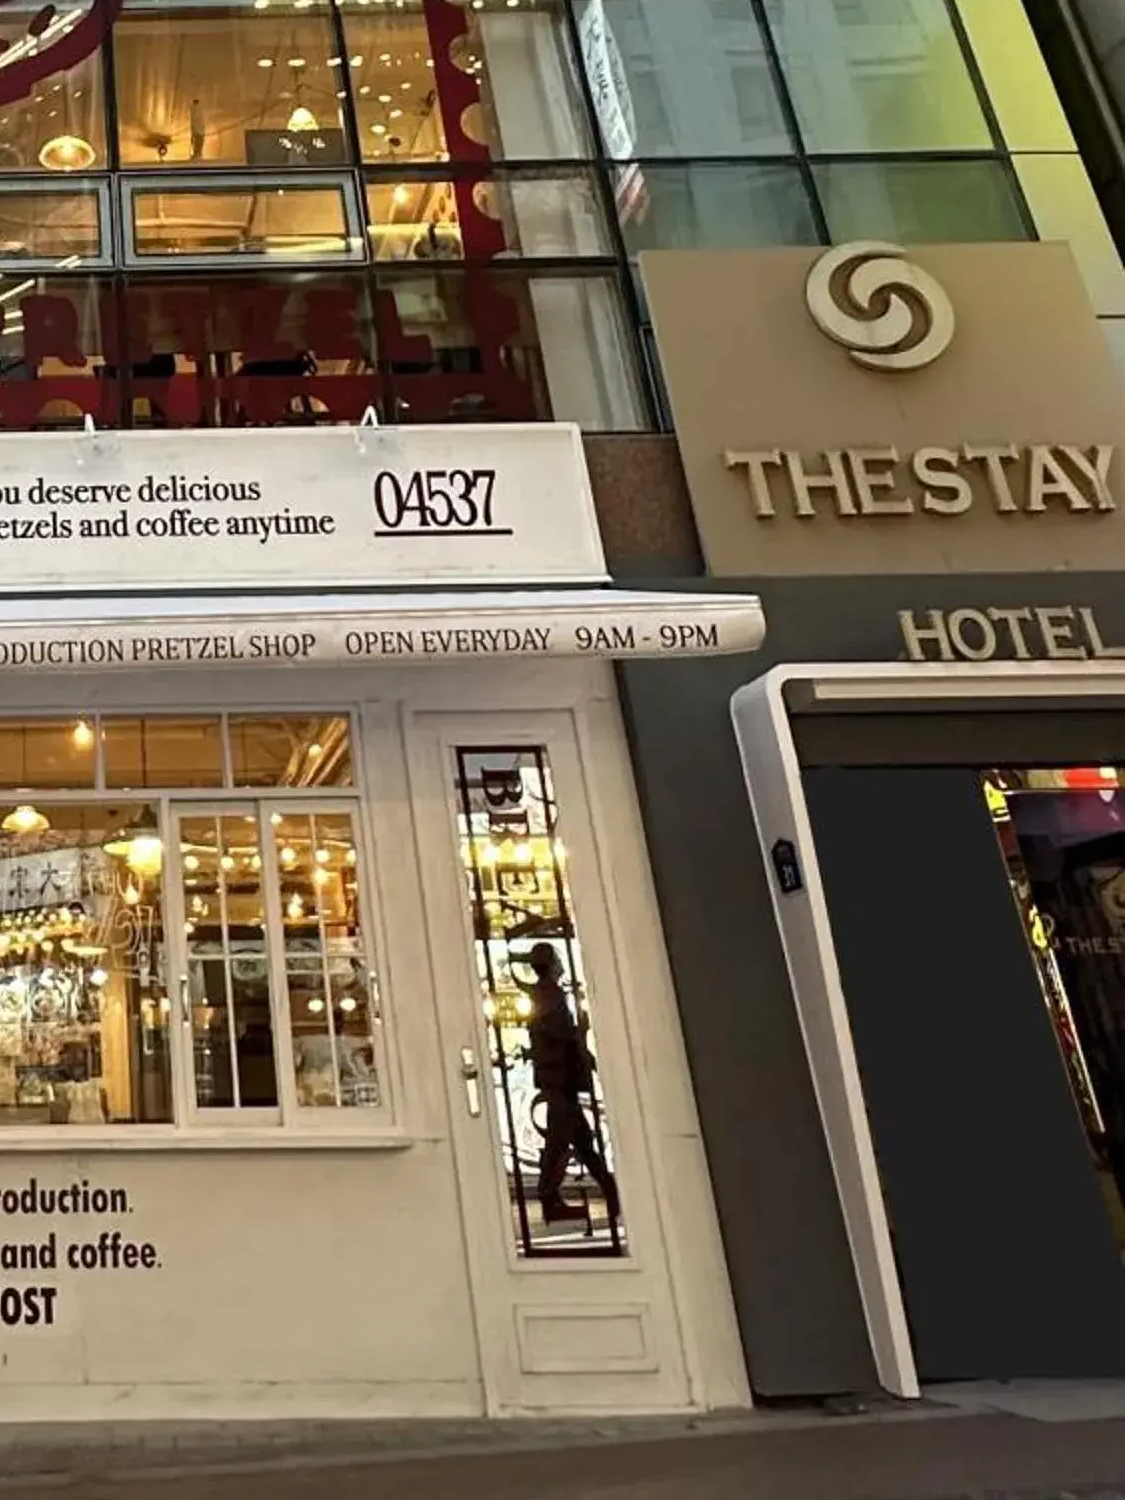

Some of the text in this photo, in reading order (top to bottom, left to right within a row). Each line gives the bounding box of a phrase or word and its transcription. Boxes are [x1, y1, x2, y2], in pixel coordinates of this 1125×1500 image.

[27, 476, 132, 506] deserve
[136, 473, 262, 503] delicious
[374, 469, 497, 529] 04537
[78, 509, 131, 538] and
[135, 507, 221, 538] coffee
[225, 507, 337, 545] anytime
[129, 634, 245, 663] PRETZEL
[248, 632, 318, 658] SHOP
[344, 629, 415, 656] OPEN
[420, 626, 554, 655] EVERYDAY
[573, 625, 637, 652] 9AM
[658, 623, 720, 650] 9PM
[897, 605, 1125, 662] HOTEL
[0, 1232, 57, 1270] and
[67, 1231, 163, 1269] coffee.
